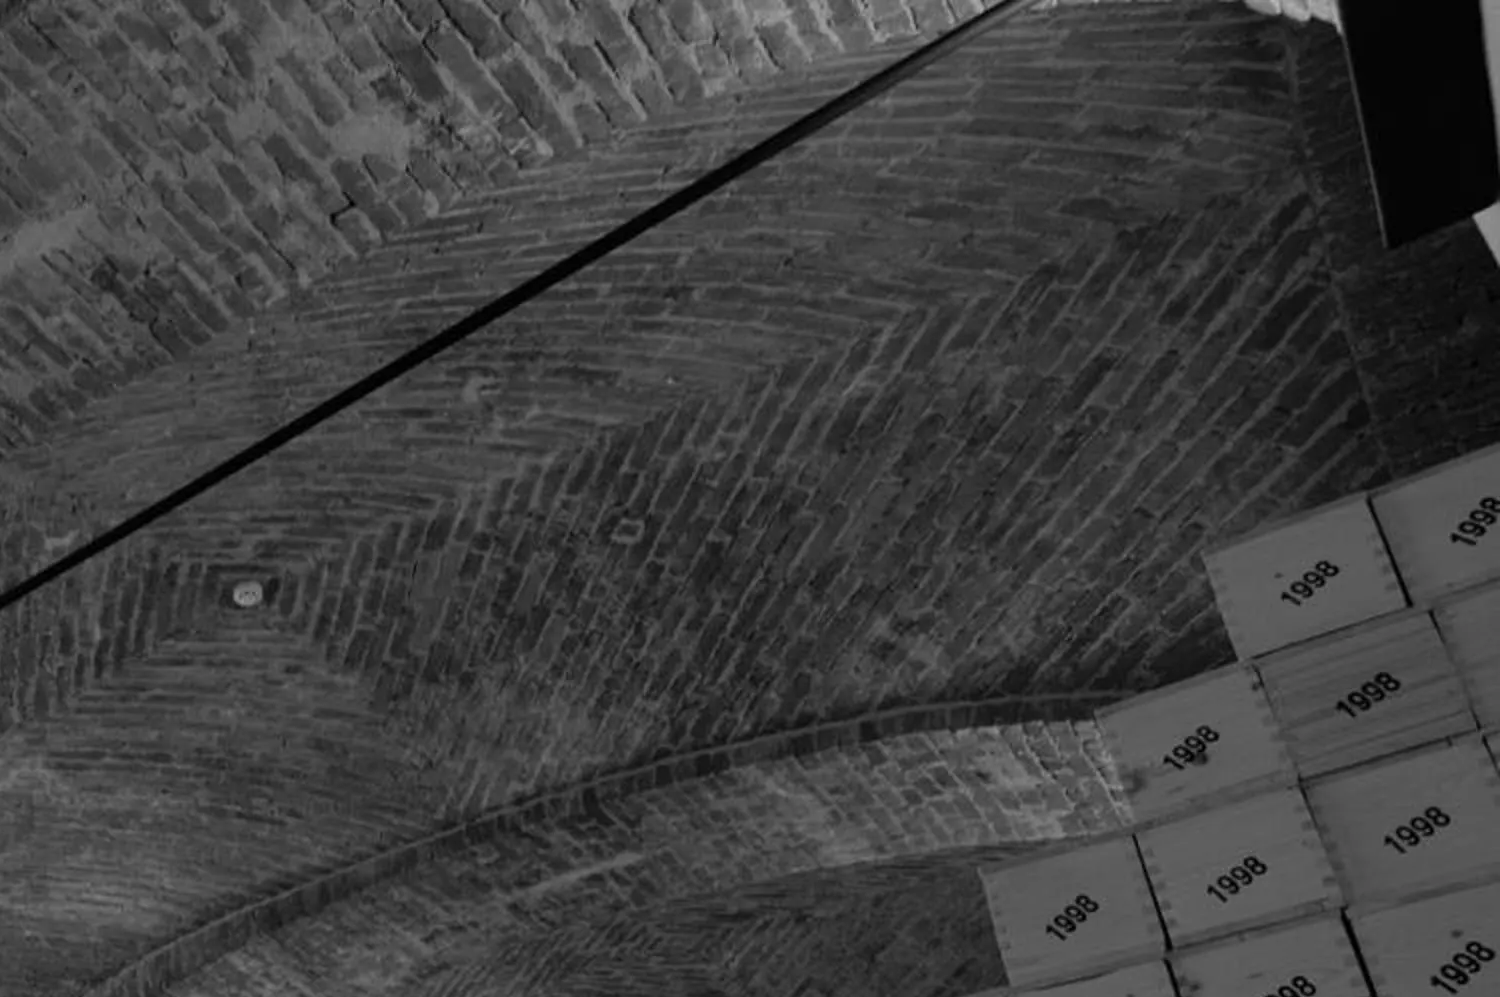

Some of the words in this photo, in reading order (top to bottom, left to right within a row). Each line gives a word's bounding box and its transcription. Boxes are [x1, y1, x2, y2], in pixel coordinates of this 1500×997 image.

[1450, 497, 1500, 546] 1998
[1280, 560, 1340, 606] 1998
[1335, 671, 1402, 718] 1998
[1163, 725, 1220, 771] 1998
[1384, 806, 1451, 854] 1998
[1206, 855, 1268, 903] 1998
[1045, 894, 1100, 941] 1998
[1430, 941, 1496, 995] 1998
